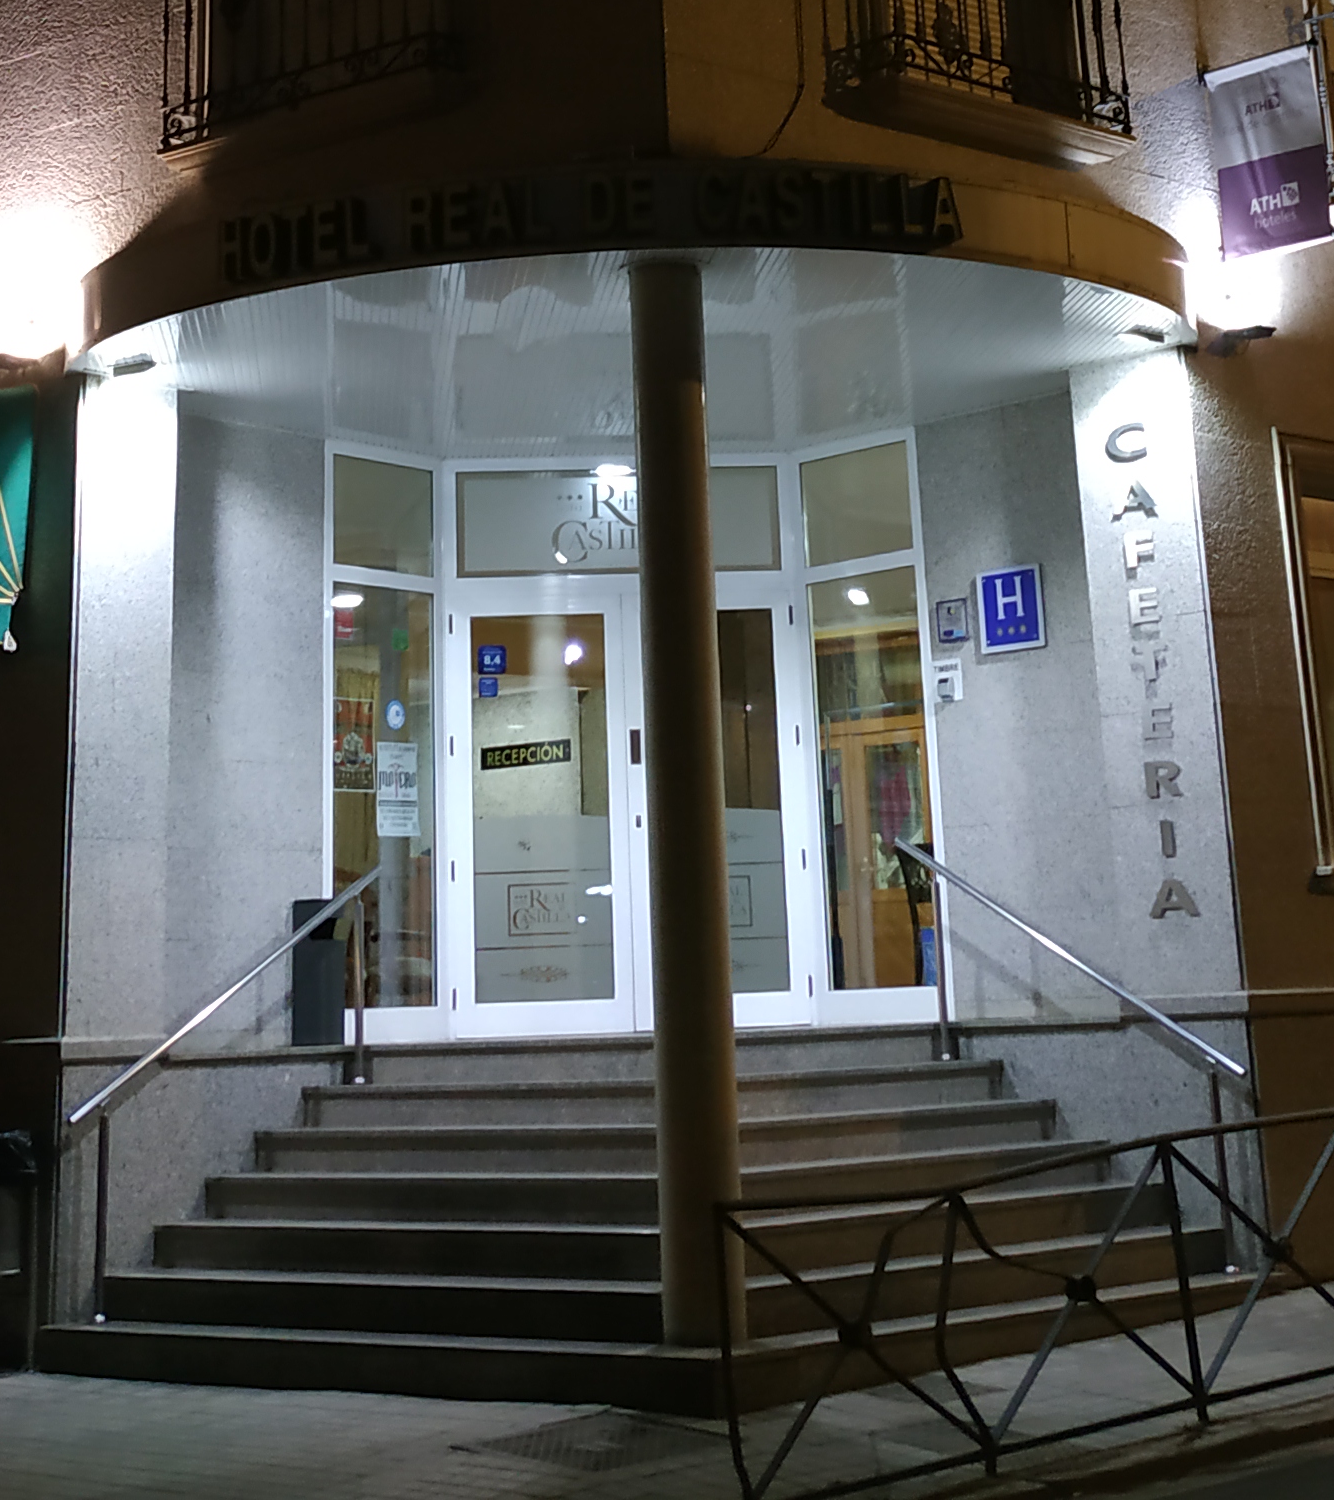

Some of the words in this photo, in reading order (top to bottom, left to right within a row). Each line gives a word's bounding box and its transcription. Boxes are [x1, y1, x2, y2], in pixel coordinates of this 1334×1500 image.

[220, 198, 371, 282] HOTEL
[404, 177, 552, 249] REAL
[583, 167, 656, 233] DE
[696, 166, 964, 239] CASTILLA
[1250, 192, 1282, 215] ATH
[993, 574, 1026, 622] H
[1104, 422, 1201, 921] CAFETERIA
[486, 741, 564, 767] RECEPCIÓN
